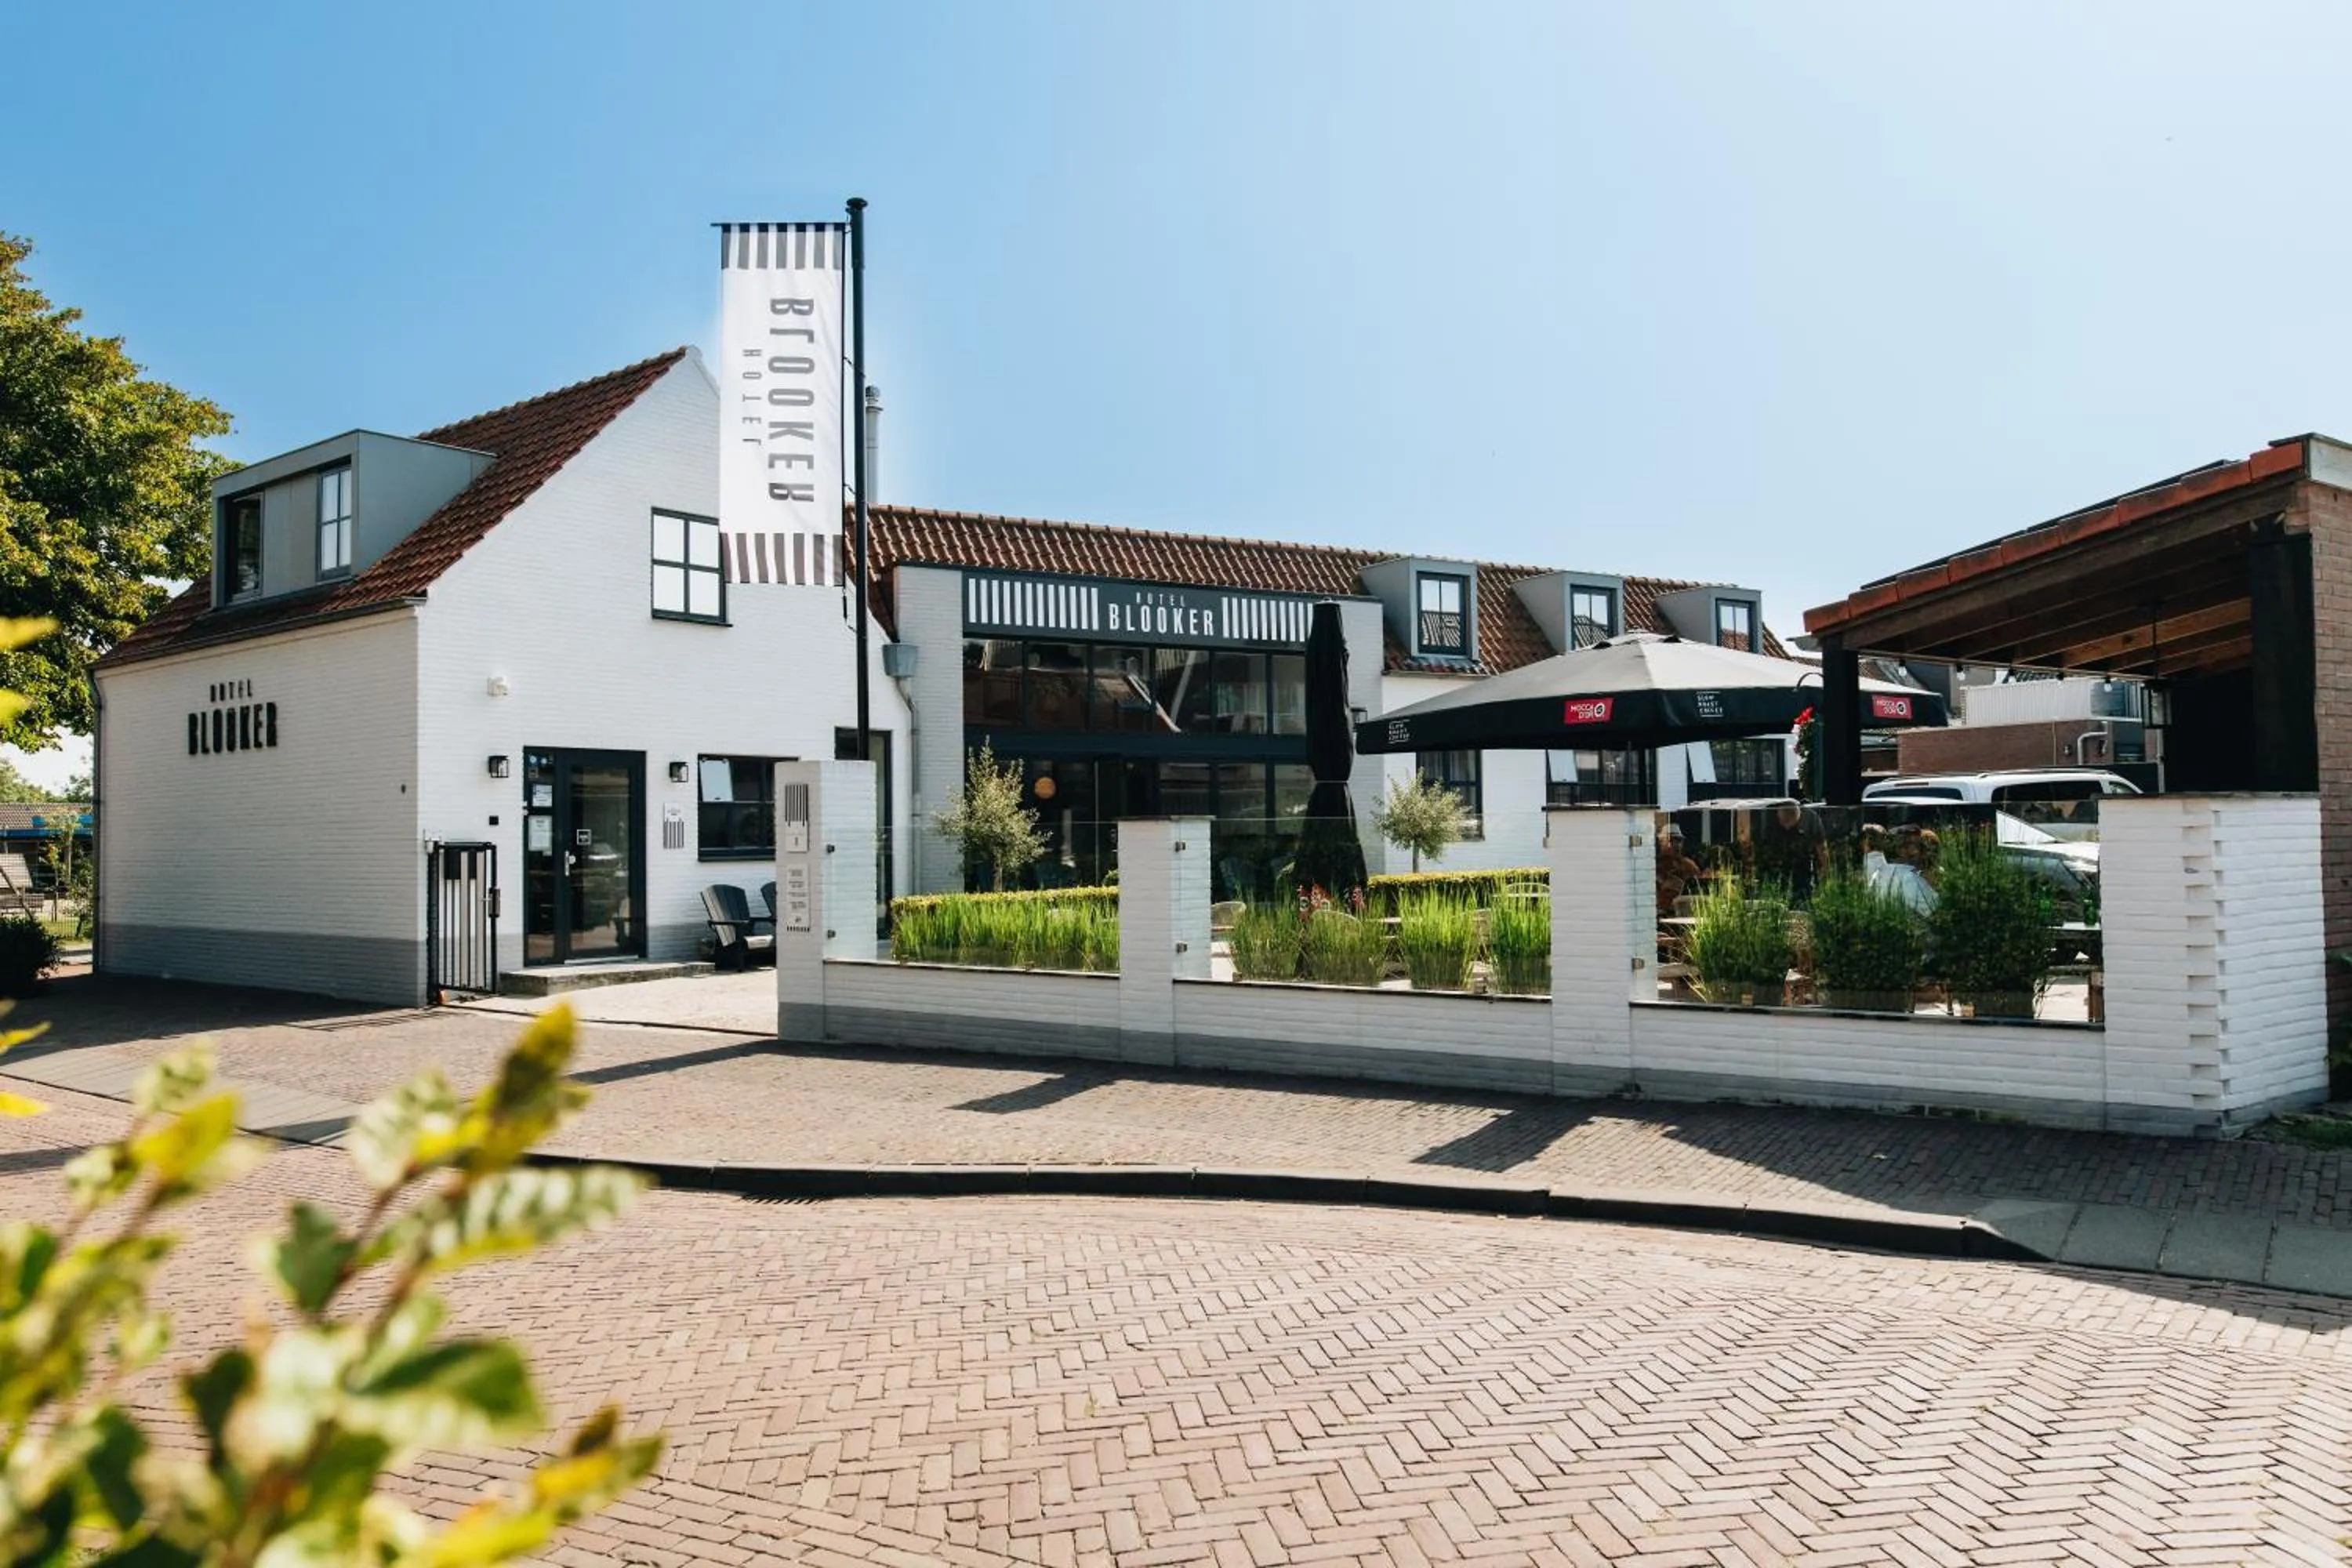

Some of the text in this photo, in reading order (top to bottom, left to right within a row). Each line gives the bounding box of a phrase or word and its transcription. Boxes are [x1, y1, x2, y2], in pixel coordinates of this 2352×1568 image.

[1136, 591, 1186, 608] HOTEL
[1108, 602, 1214, 637] BLOOKER
[209, 677, 253, 702] HOTEL
[187, 701, 278, 755] BLOOKER
